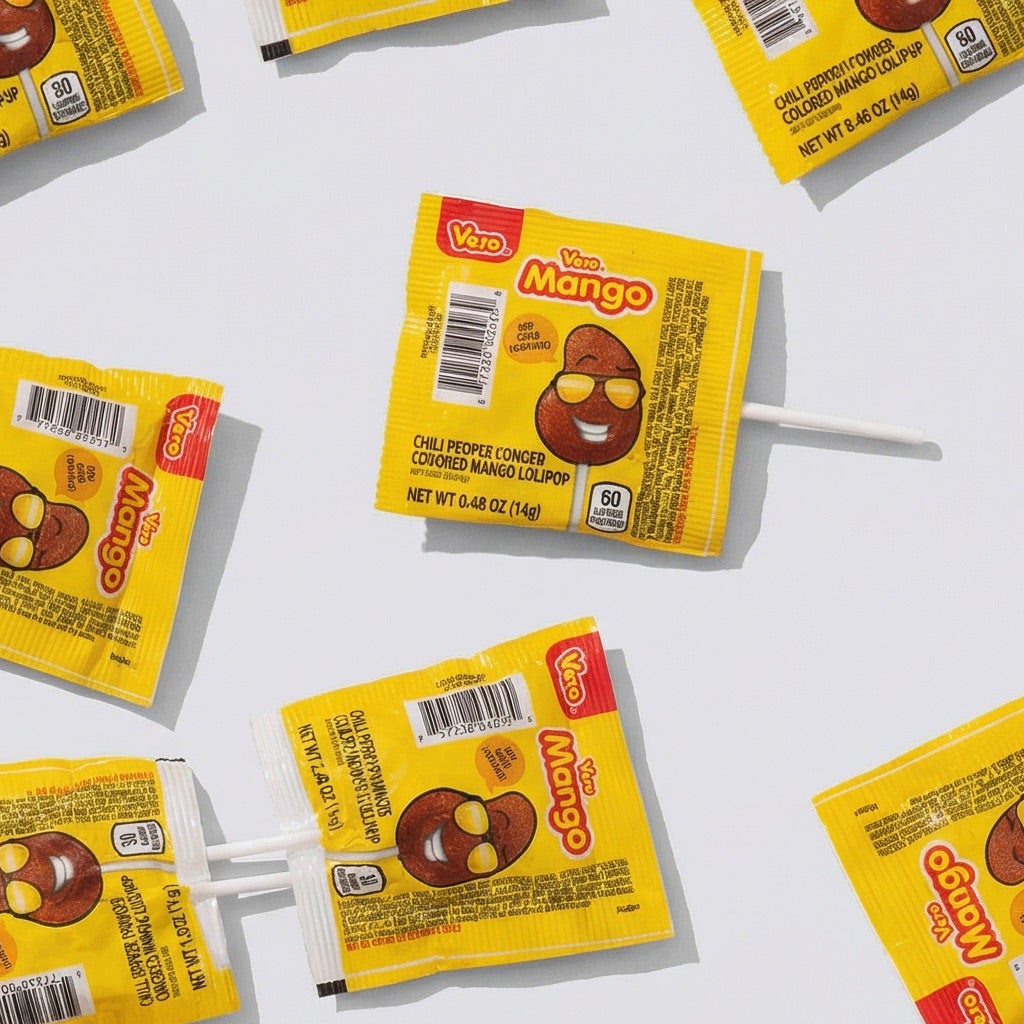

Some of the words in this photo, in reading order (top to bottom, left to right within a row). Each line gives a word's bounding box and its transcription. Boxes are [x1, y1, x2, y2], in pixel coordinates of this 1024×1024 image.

[954, 25, 977, 48] 80
[832, 65, 878, 99] MANGO
[797, 134, 824, 159] NET
[821, 122, 845, 145] WT
[870, 97, 892, 118] OZ
[888, 81, 921, 112] (14g)
[452, 224, 501, 251] Vero
[520, 261, 651, 313] Mango
[413, 434, 445, 453] CHILI
[469, 457, 517, 480] MANGO
[517, 465, 571, 487] LOLIPOP
[406, 486, 434, 505] NET
[434, 489, 457, 508] WT
[457, 493, 488, 512] 0.48
[488, 497, 508, 515] OZ
[508, 499, 542, 522] (14g)
[600, 488, 622, 509] 60
[100, 468, 151, 590] Mango
[303, 742, 323, 762] WT
[540, 732, 589, 853] Mango
[926, 847, 1001, 962] Mango
